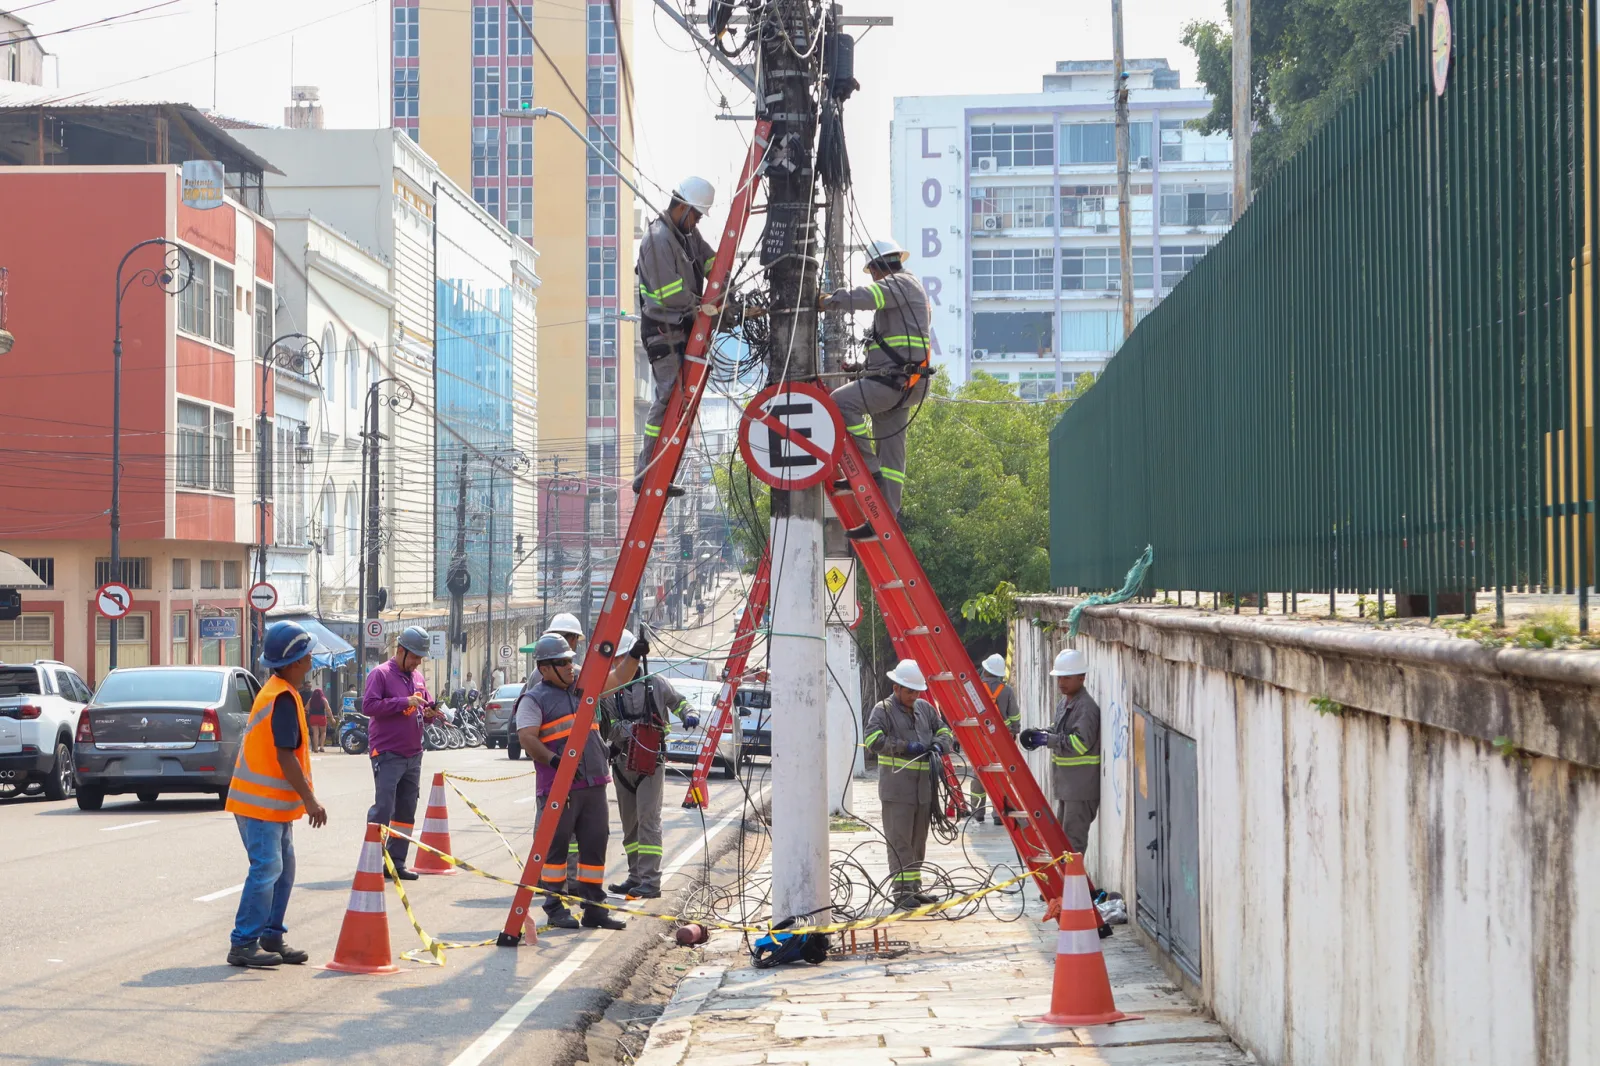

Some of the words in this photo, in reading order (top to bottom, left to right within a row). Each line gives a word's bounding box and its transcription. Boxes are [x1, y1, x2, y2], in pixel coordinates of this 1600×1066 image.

[183, 187, 223, 200] HOTEL
[767, 403, 817, 468] E
[371, 624, 379, 634] E
[432, 635, 440, 645] E
[502, 647, 510, 656] E
